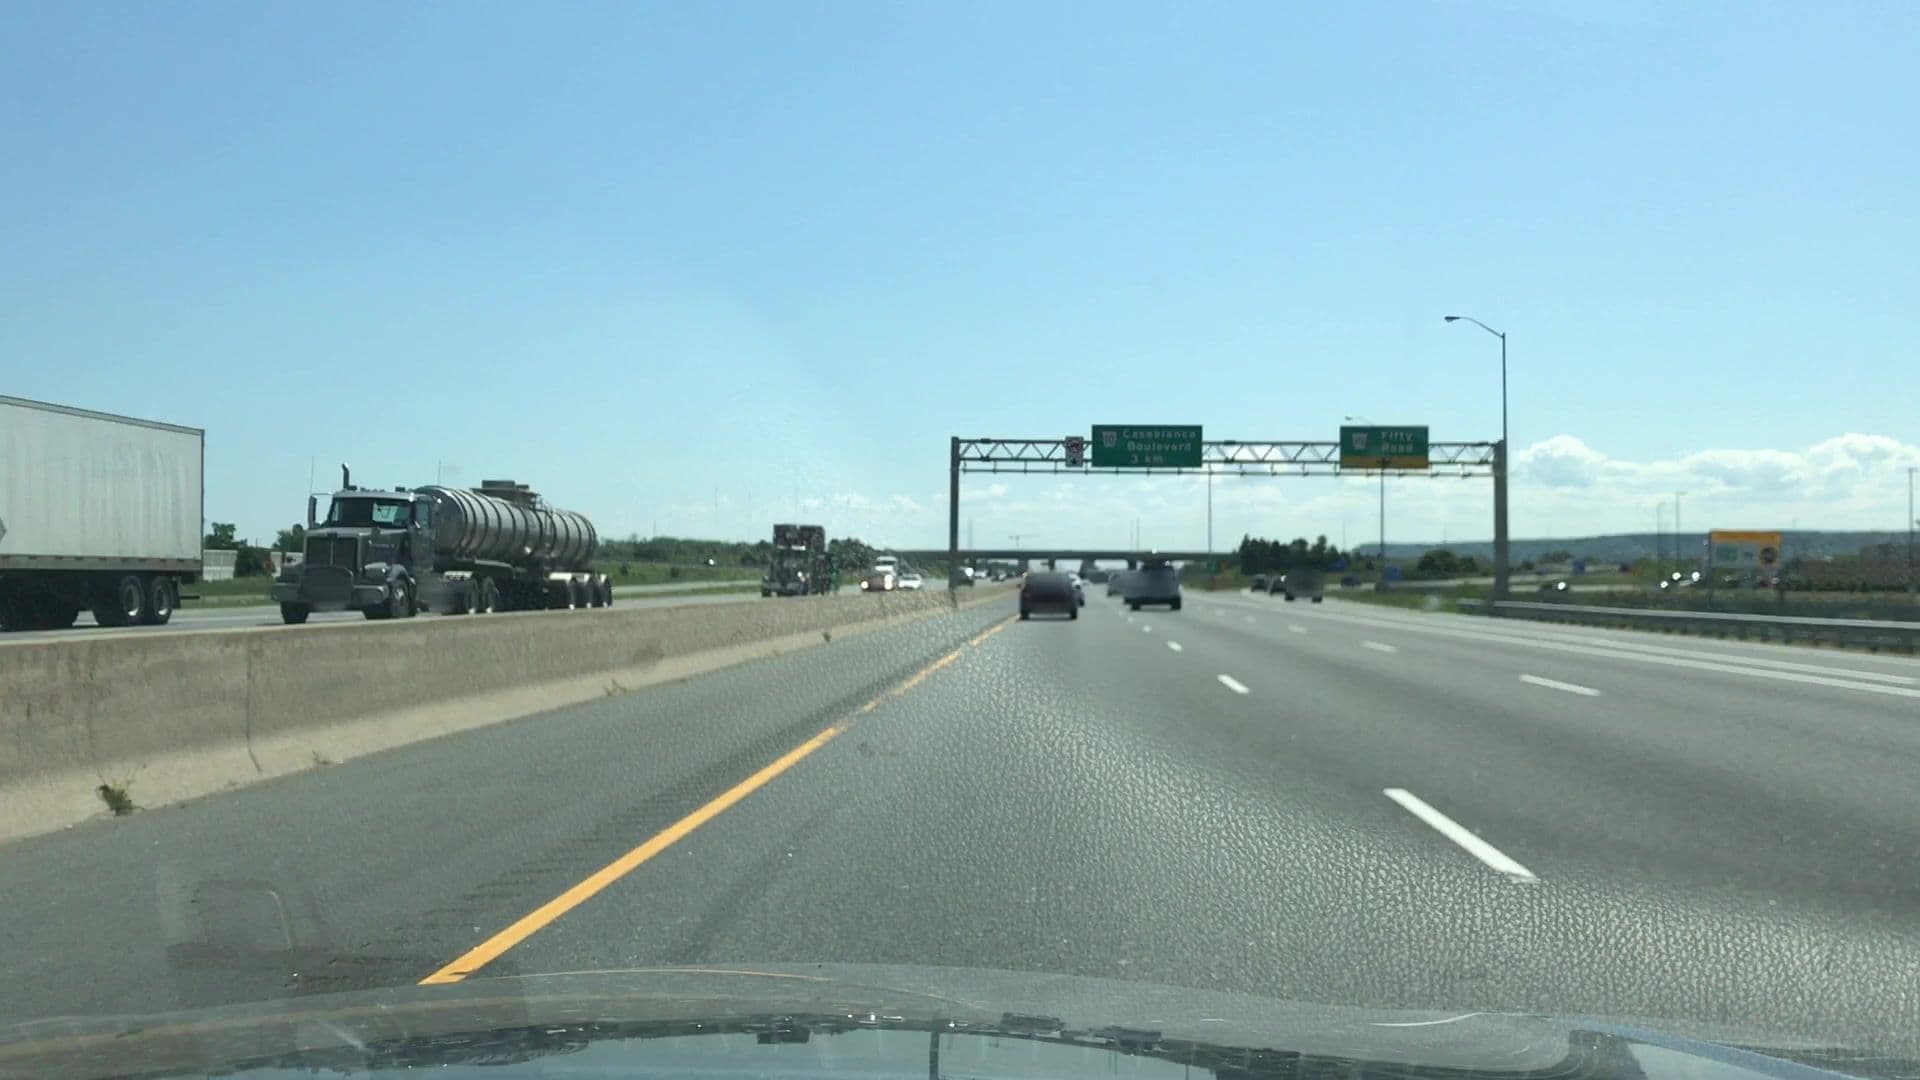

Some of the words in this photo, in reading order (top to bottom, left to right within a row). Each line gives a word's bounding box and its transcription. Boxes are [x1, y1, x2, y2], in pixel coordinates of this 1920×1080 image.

[1123, 429, 1196, 439] Casablanca
[1127, 442, 1192, 451] Boulevard
[1145, 455, 1163, 464] km
